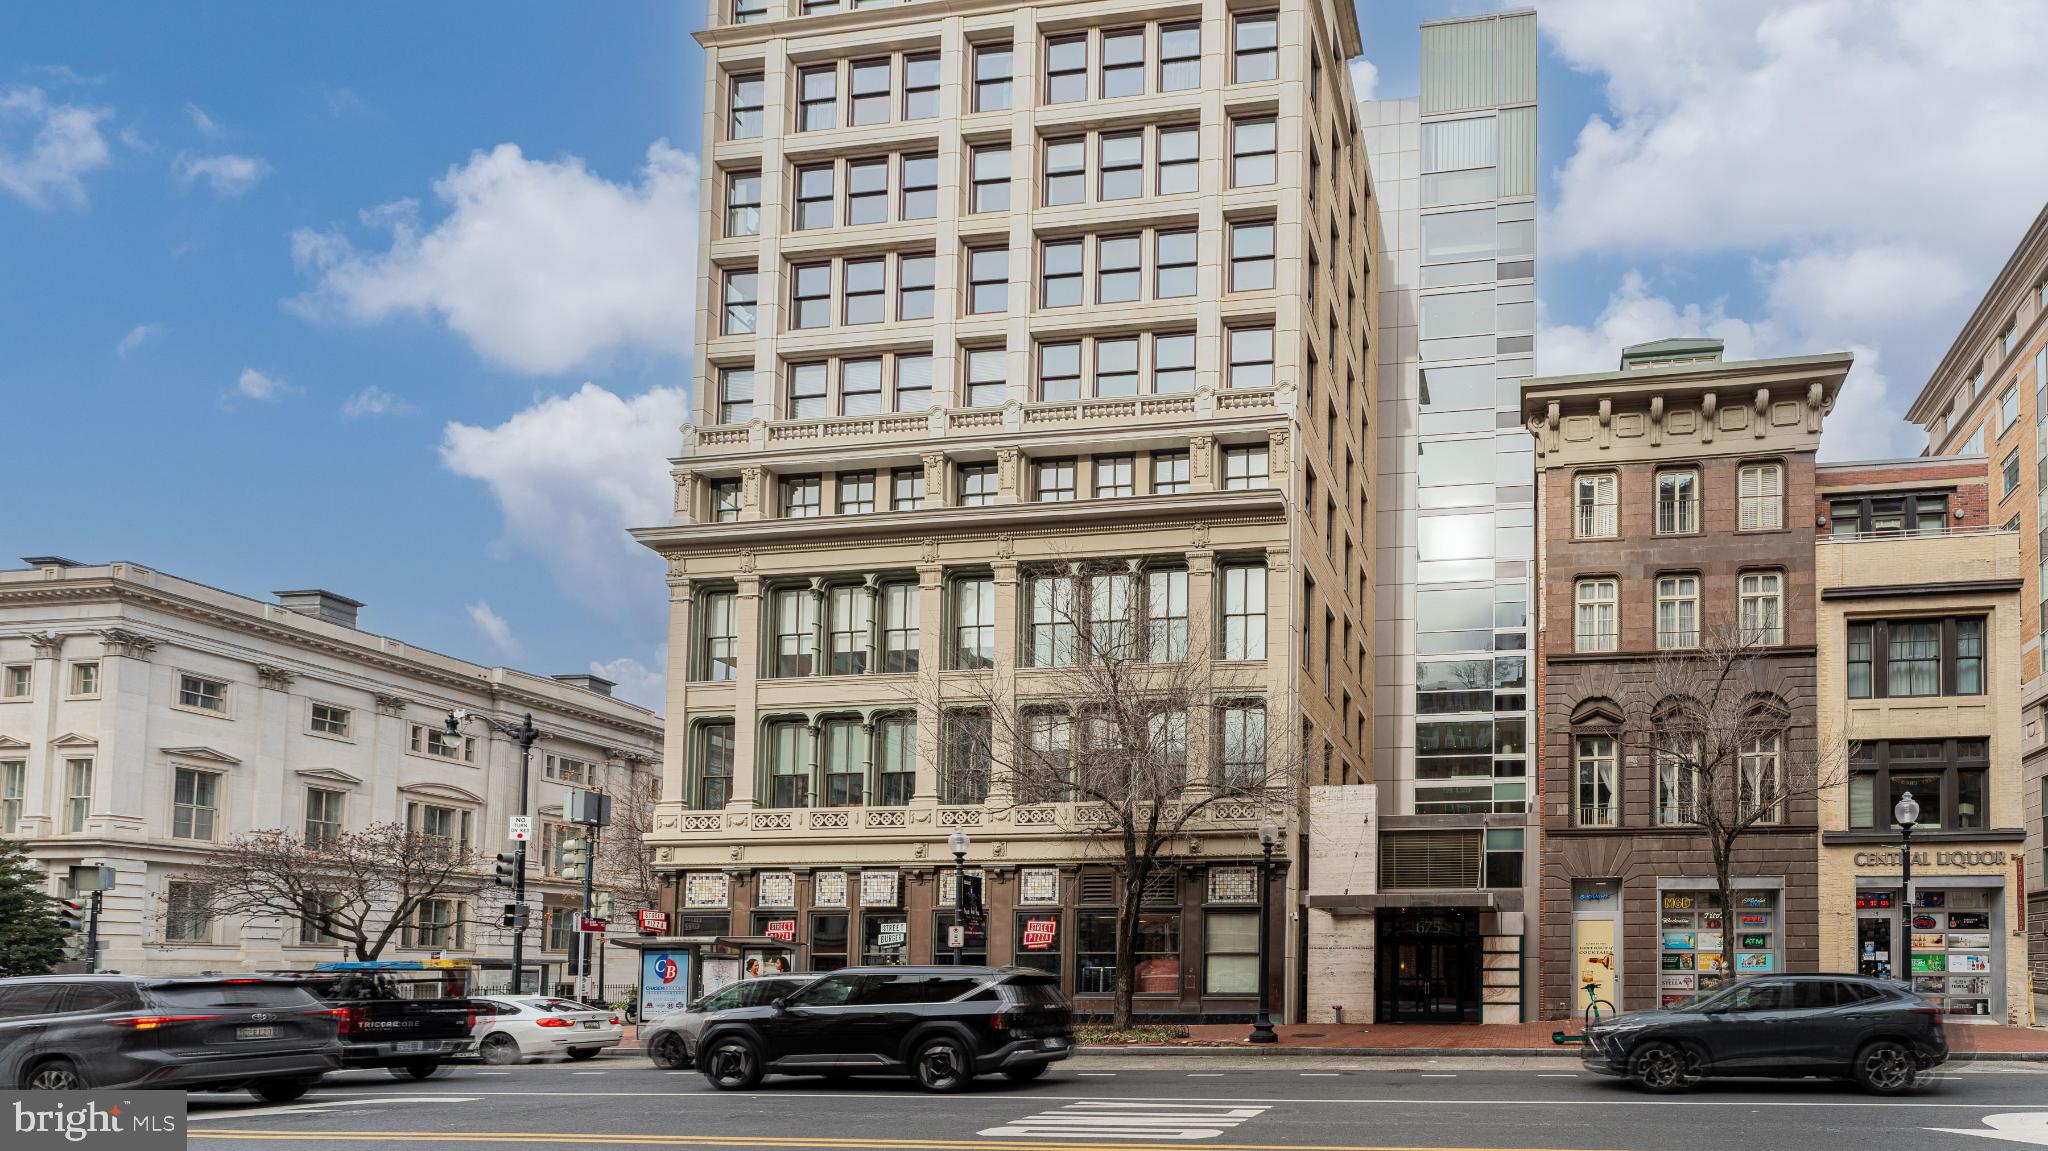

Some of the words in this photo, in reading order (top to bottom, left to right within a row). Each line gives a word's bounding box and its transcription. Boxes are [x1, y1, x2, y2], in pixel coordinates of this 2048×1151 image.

[1936, 851, 2006, 868] LIQUOR
[1664, 897, 1691, 909] MGD
[645, 911, 664, 919] STREET
[646, 920, 664, 928] PIZZA
[770, 922, 792, 931] STREET
[1030, 923, 1051, 931] STREET
[1416, 919, 1441, 934] 675
[880, 934, 903, 944] BURGER
[1028, 933, 1049, 942] PIZZA
[1744, 937, 1764, 945] ATM
